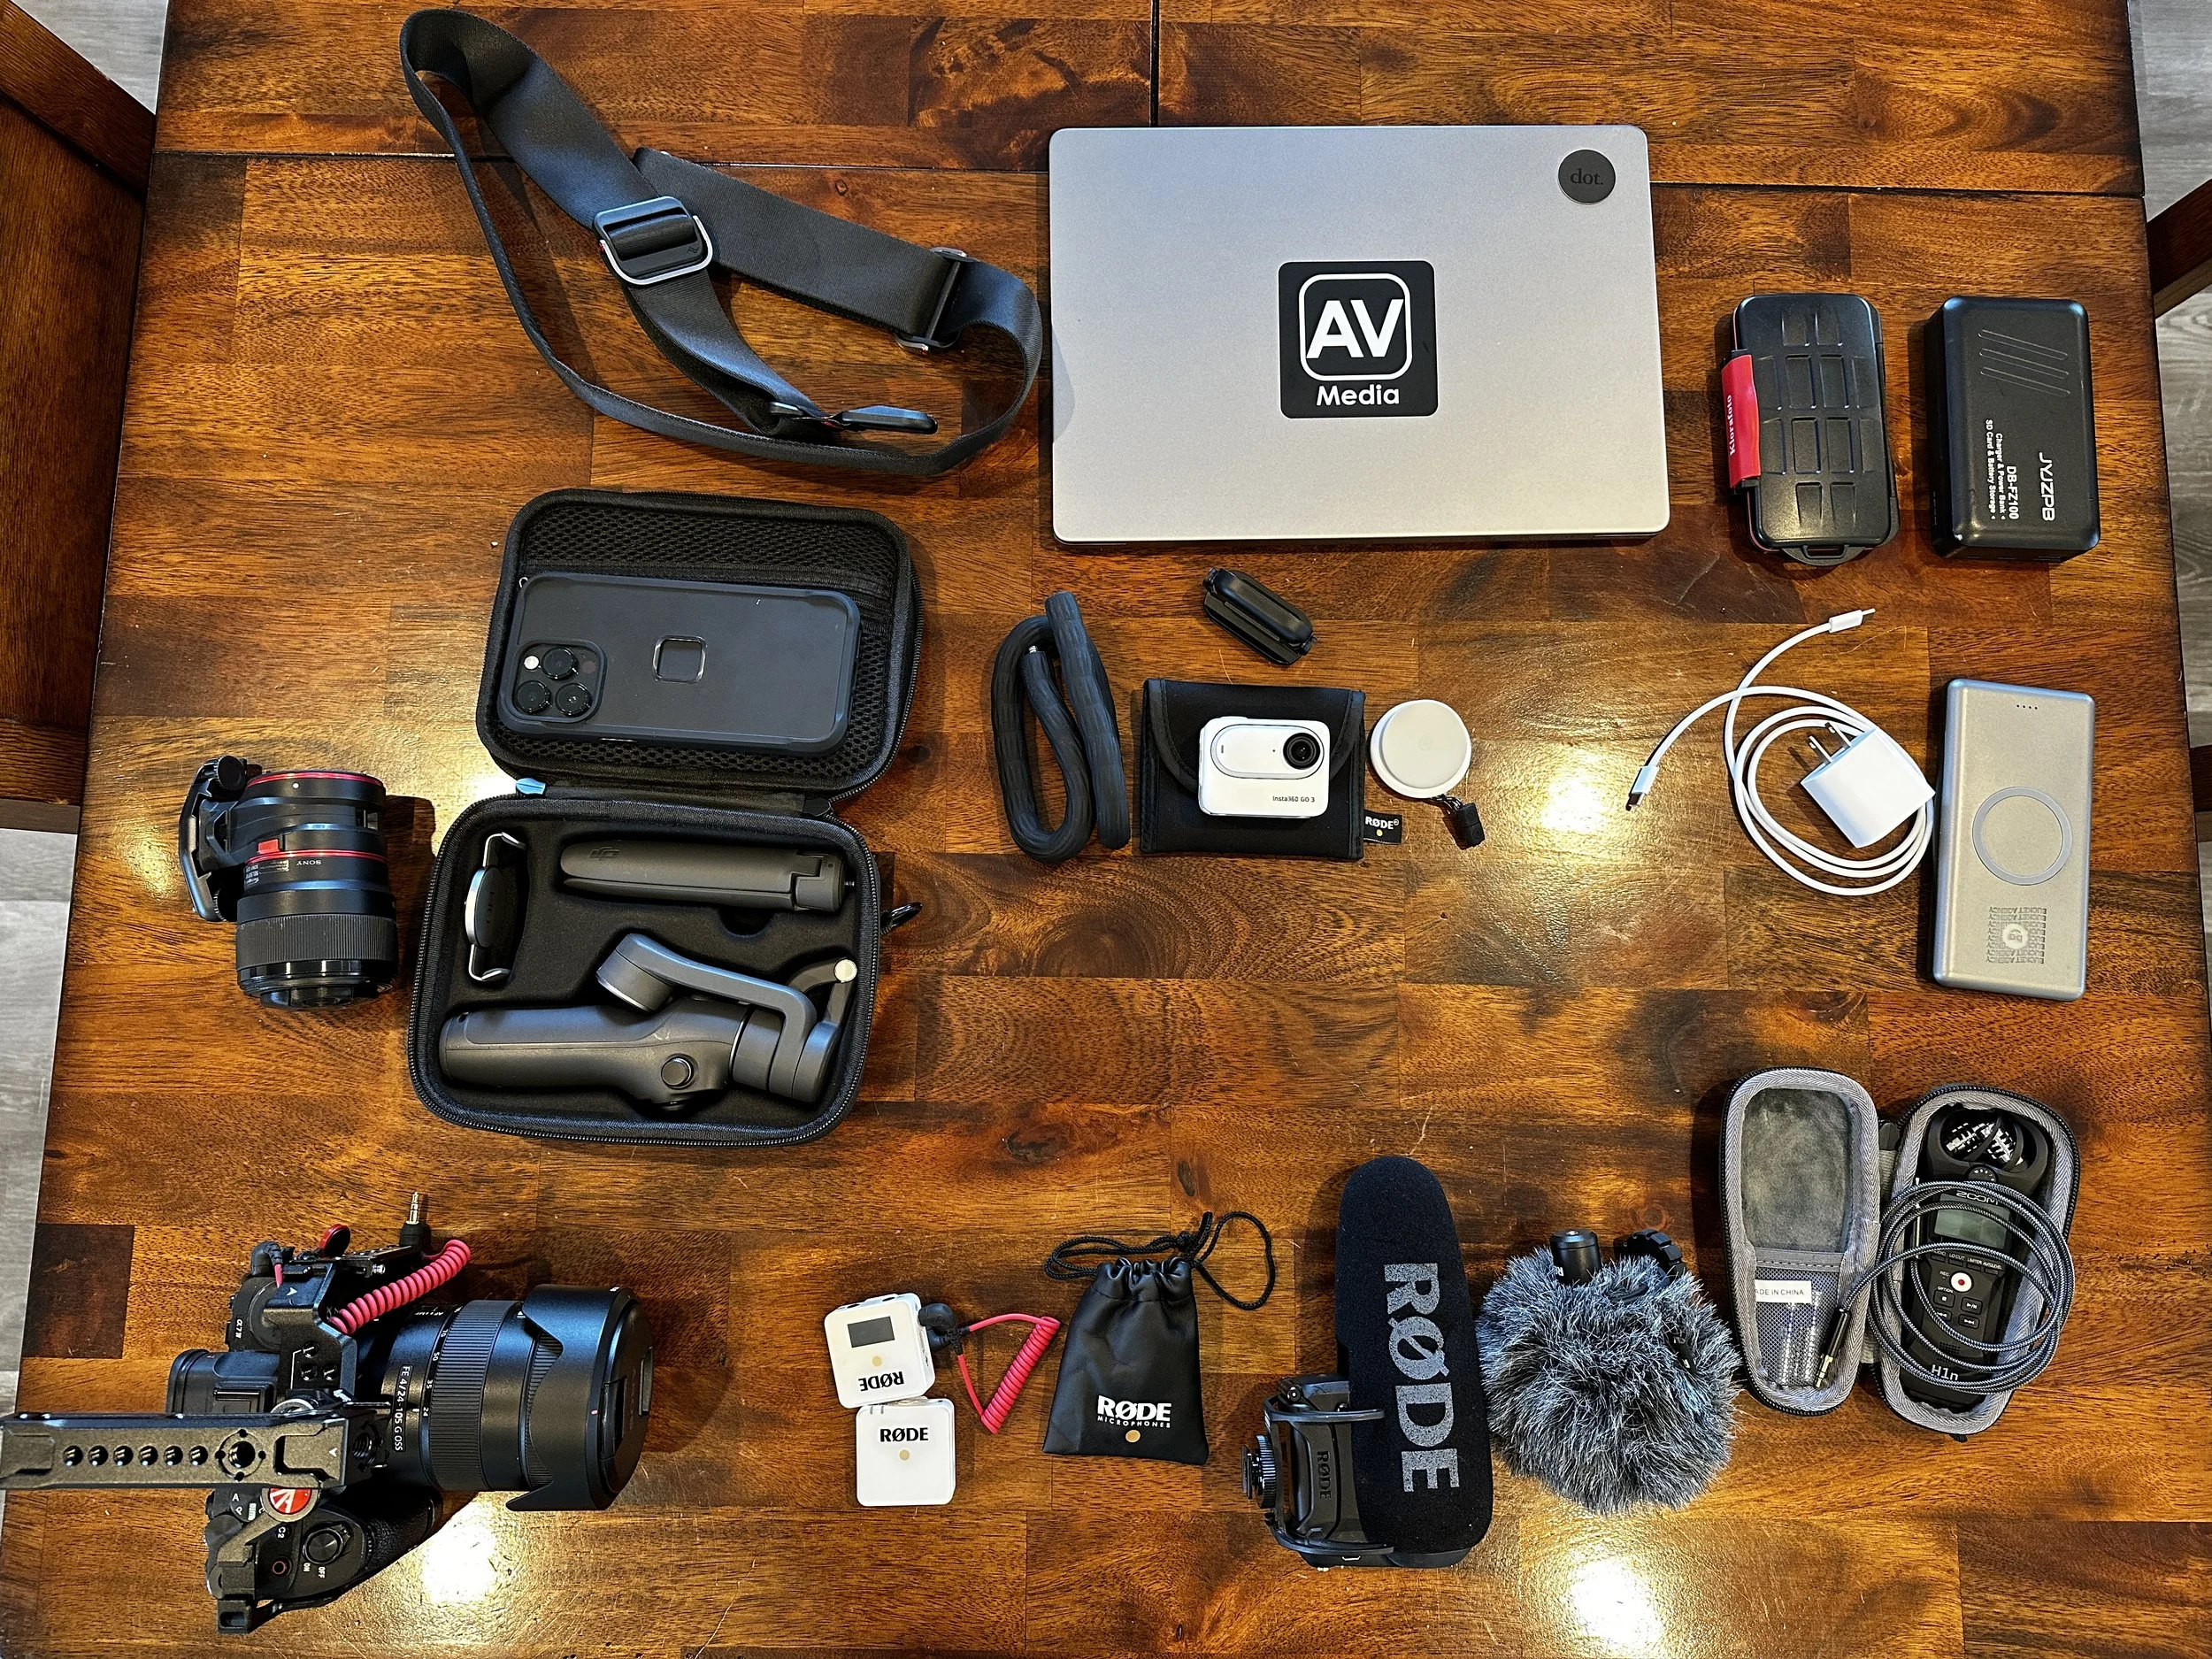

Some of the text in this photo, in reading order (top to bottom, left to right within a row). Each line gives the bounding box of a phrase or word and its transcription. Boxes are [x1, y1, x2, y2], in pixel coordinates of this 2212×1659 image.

[1305, 298, 1404, 359] AV
[1316, 383, 1400, 406] Media
[1985, 419, 1993, 431] SD
[1985, 431, 1994, 449] Card
[2006, 465, 2019, 520] DB-FZ100
[2039, 451, 2055, 521] JYJZPB
[401, 1365, 411, 1377] FE
[1383, 1263, 1460, 1493] RØDE
[1932, 1363, 1959, 1381] H1n
[426, 1379, 434, 1389] 35
[857, 1371, 905, 1392] RØDE
[422, 1406, 429, 1417] 24
[1097, 1394, 1172, 1422] RØDE
[394, 1425, 403, 1434] G
[1097, 1415, 1171, 1429] MICROPHONES
[879, 1426, 929, 1442] RØDE
[394, 1435, 403, 1452] OSS
[231, 1493, 240, 1502] A
[234, 1506, 243, 1516] P
[277, 1526, 287, 1539] C2
[303, 1562, 311, 1572] ON
